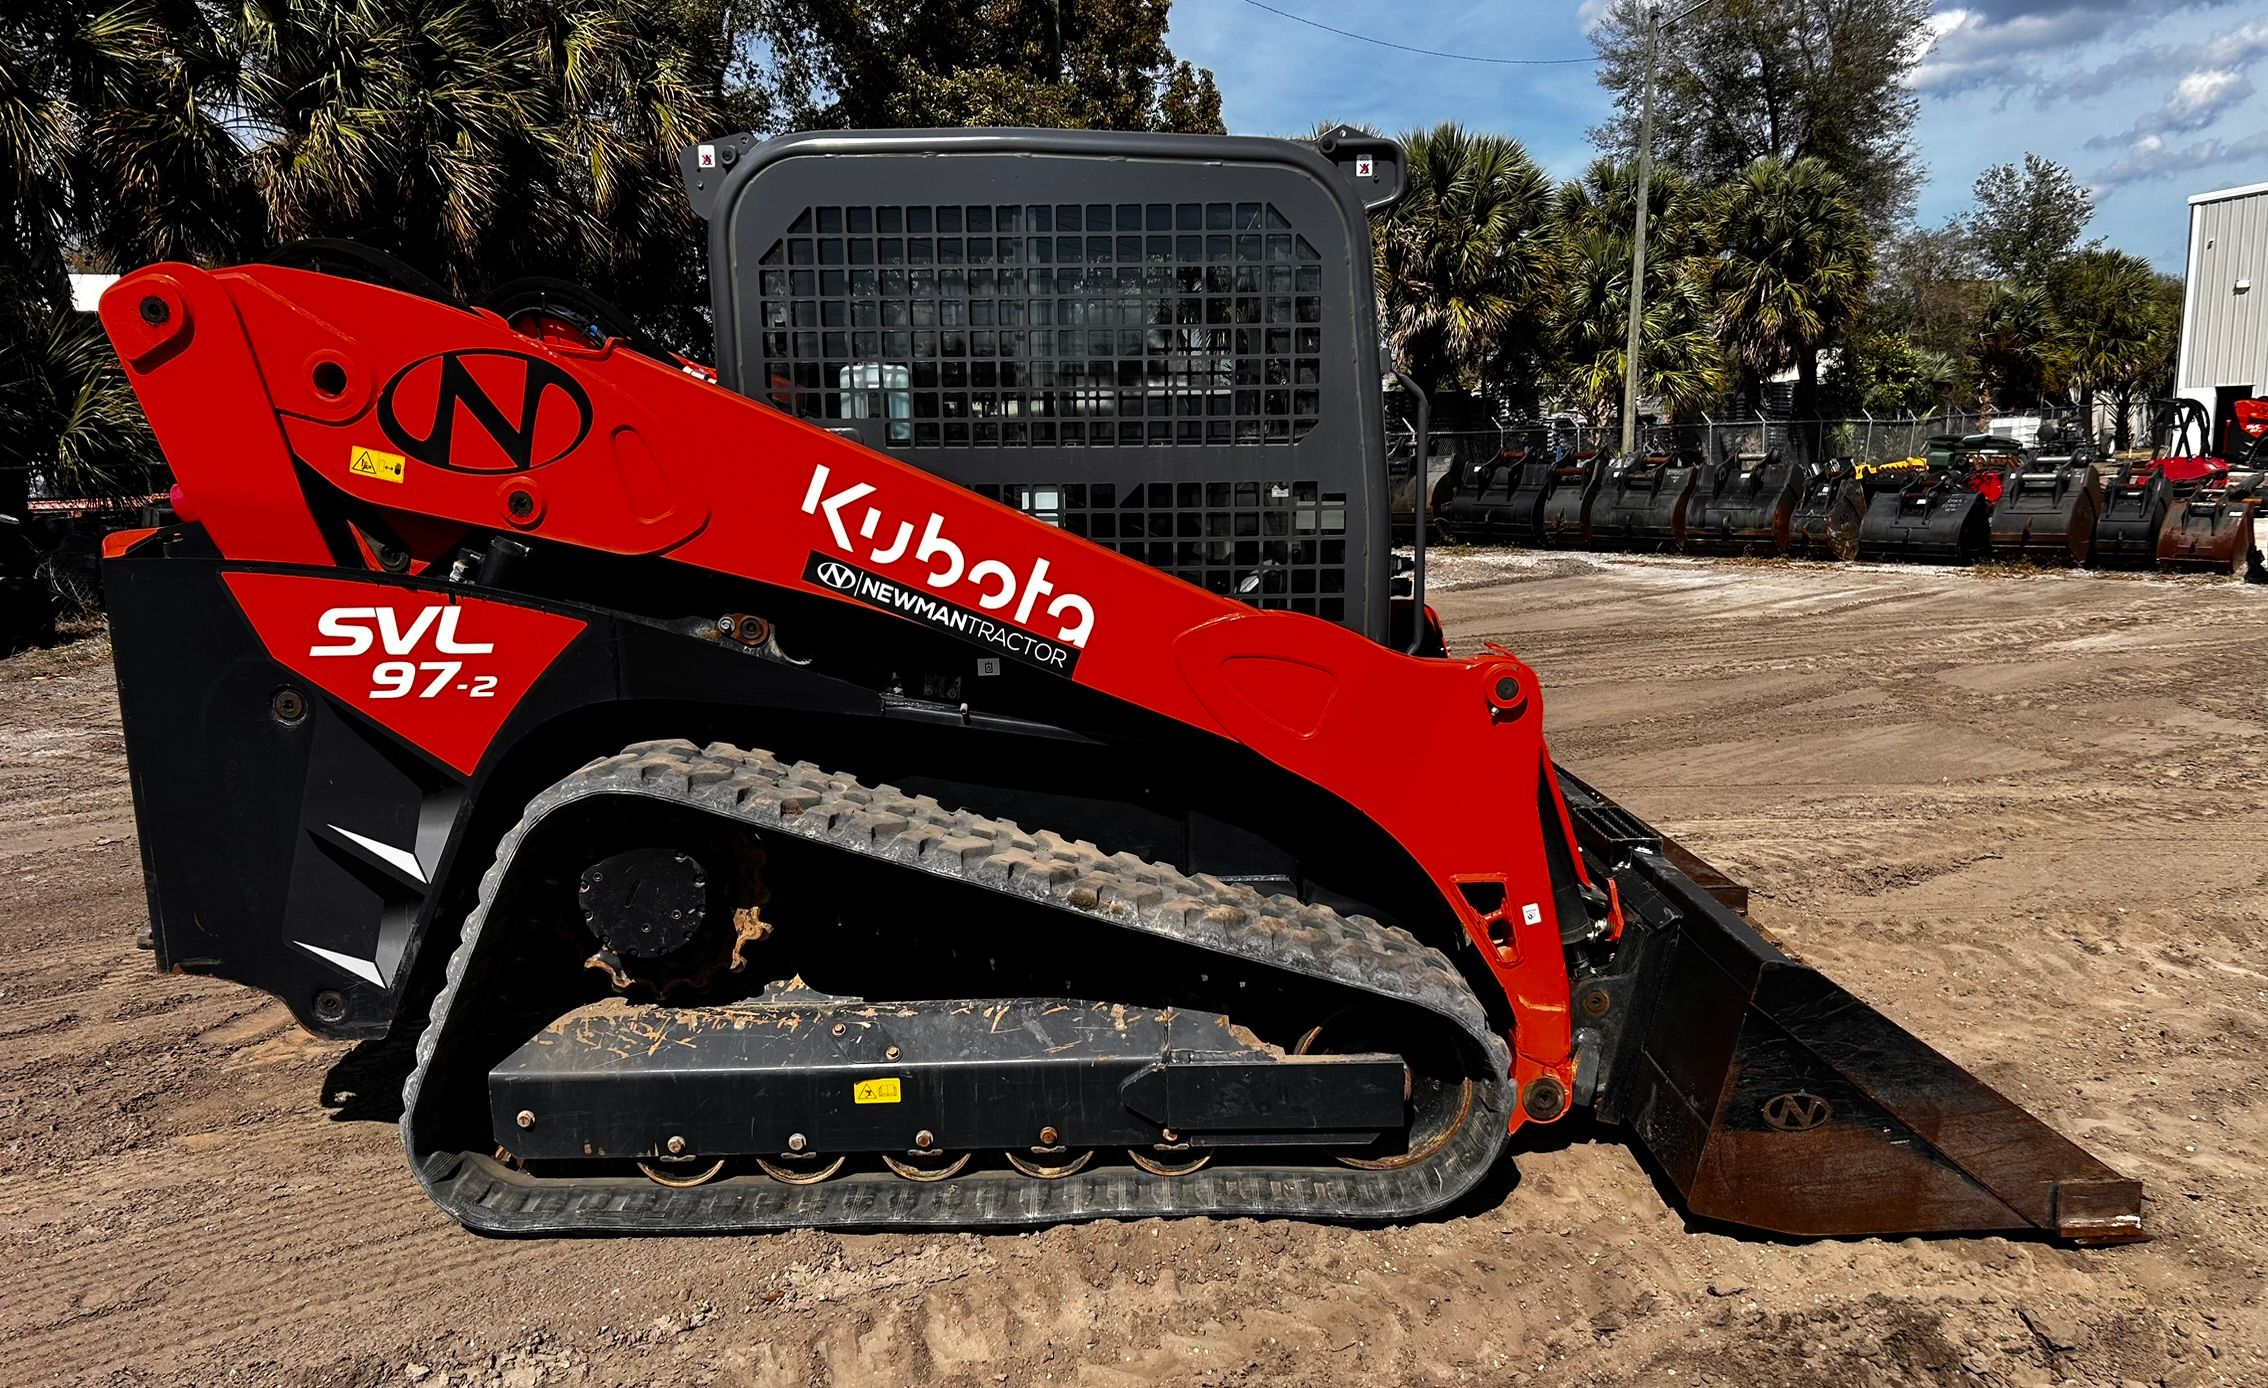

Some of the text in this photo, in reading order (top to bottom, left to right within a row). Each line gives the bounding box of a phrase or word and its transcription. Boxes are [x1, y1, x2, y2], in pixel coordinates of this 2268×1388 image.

[801, 463, 1095, 649] Kubota
[309, 606, 494, 657] SVL
[369, 661, 498, 699] 97-2
